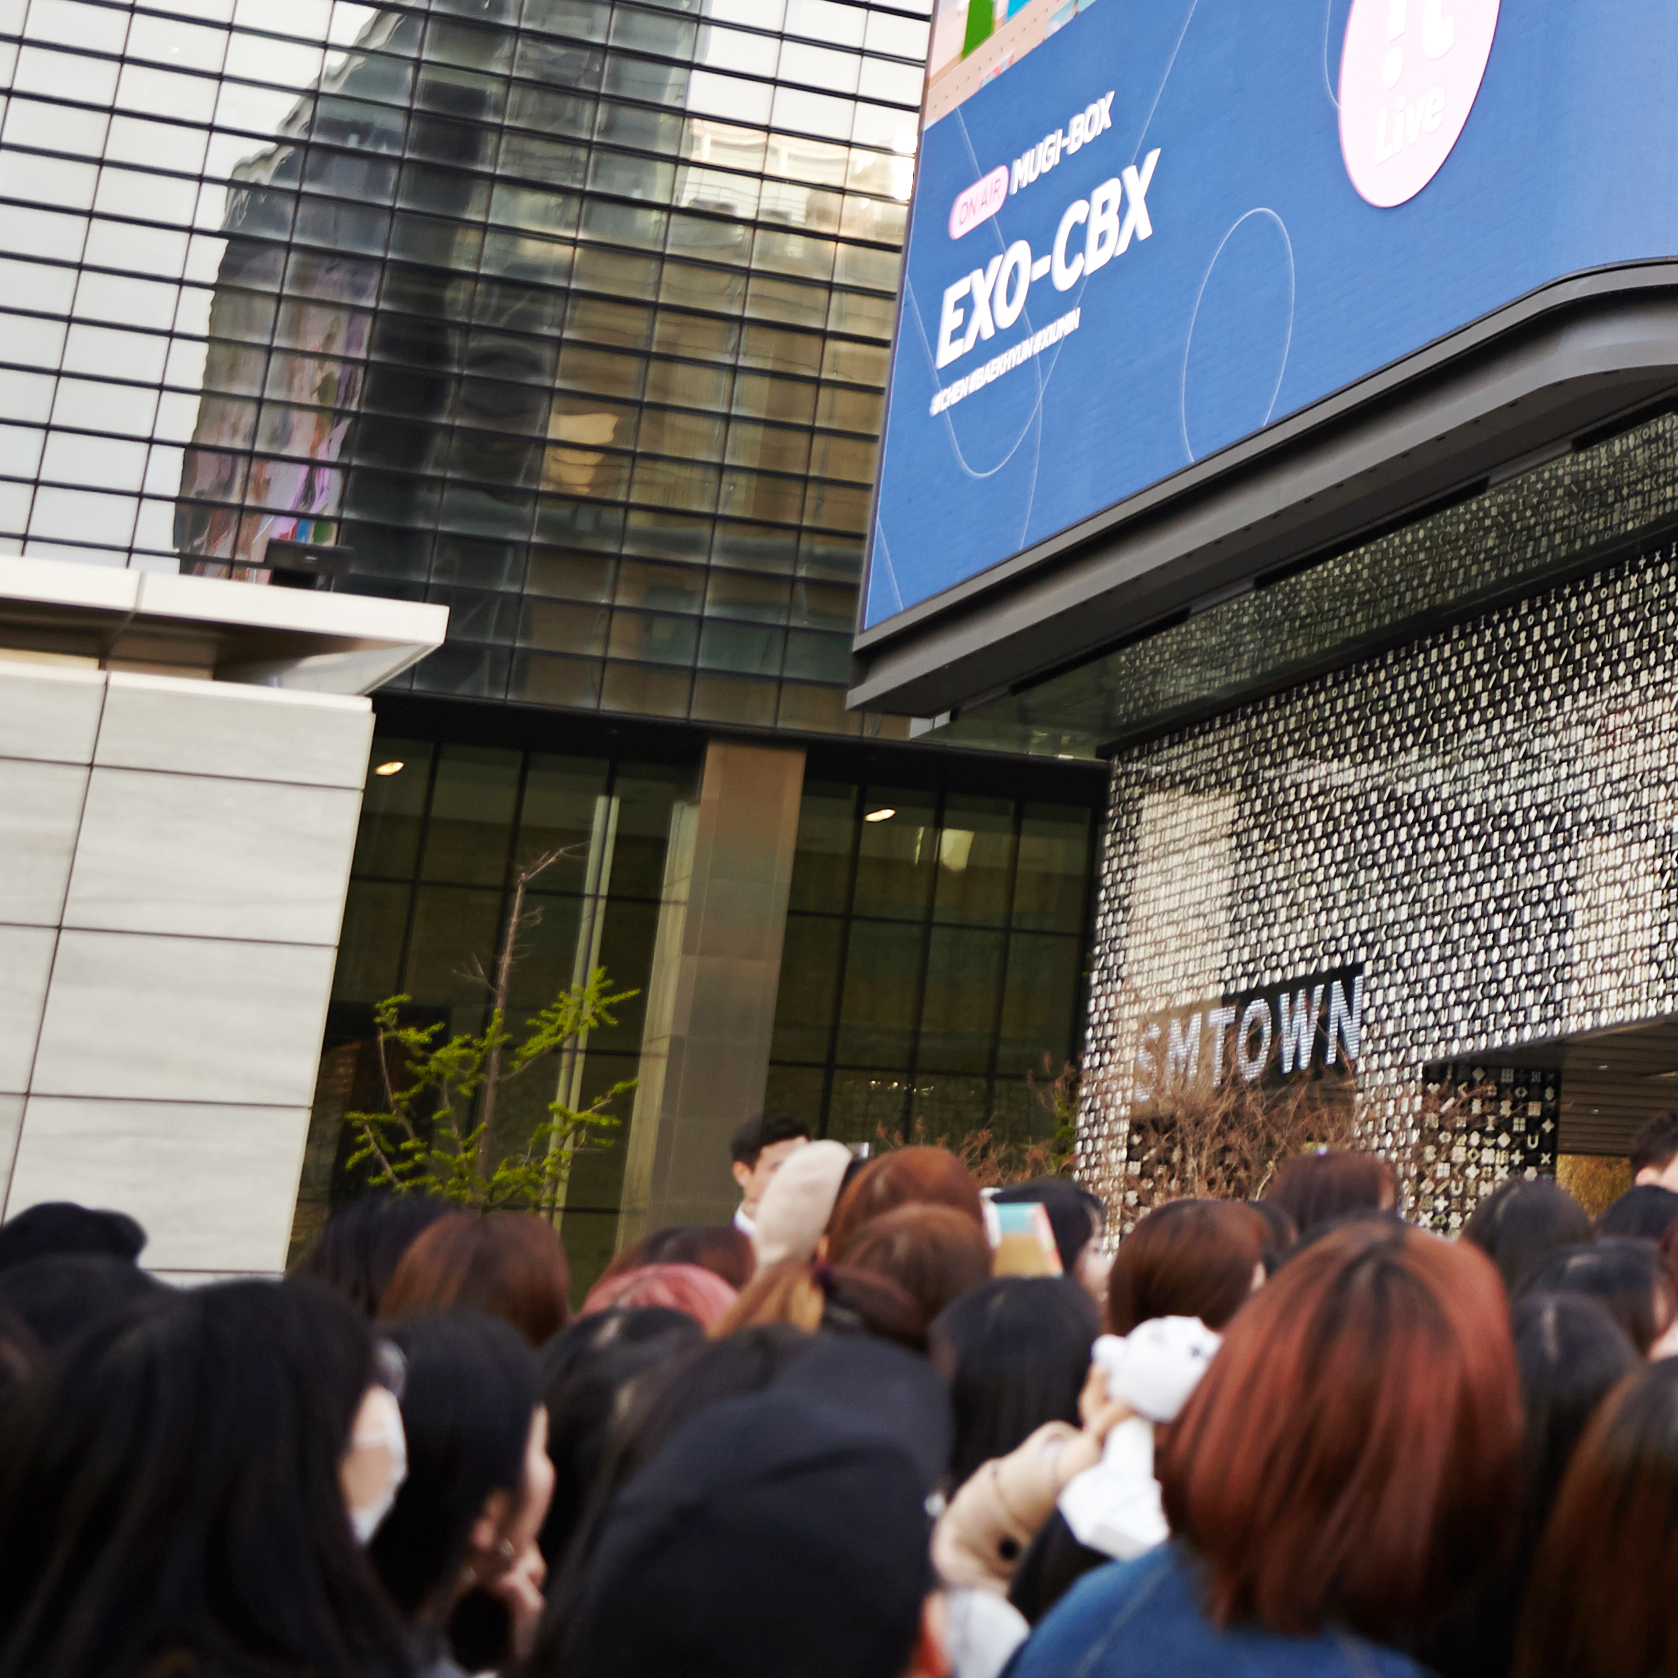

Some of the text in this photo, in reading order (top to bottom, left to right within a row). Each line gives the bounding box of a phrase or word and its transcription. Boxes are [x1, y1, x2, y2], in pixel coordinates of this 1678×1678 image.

[959, 90, 1115, 226] ON AIR MUGI-BOX
[1374, 85, 1446, 165] Live
[935, 147, 1161, 370] EXO-CBX
[1134, 974, 1364, 1103] SMTOWN
